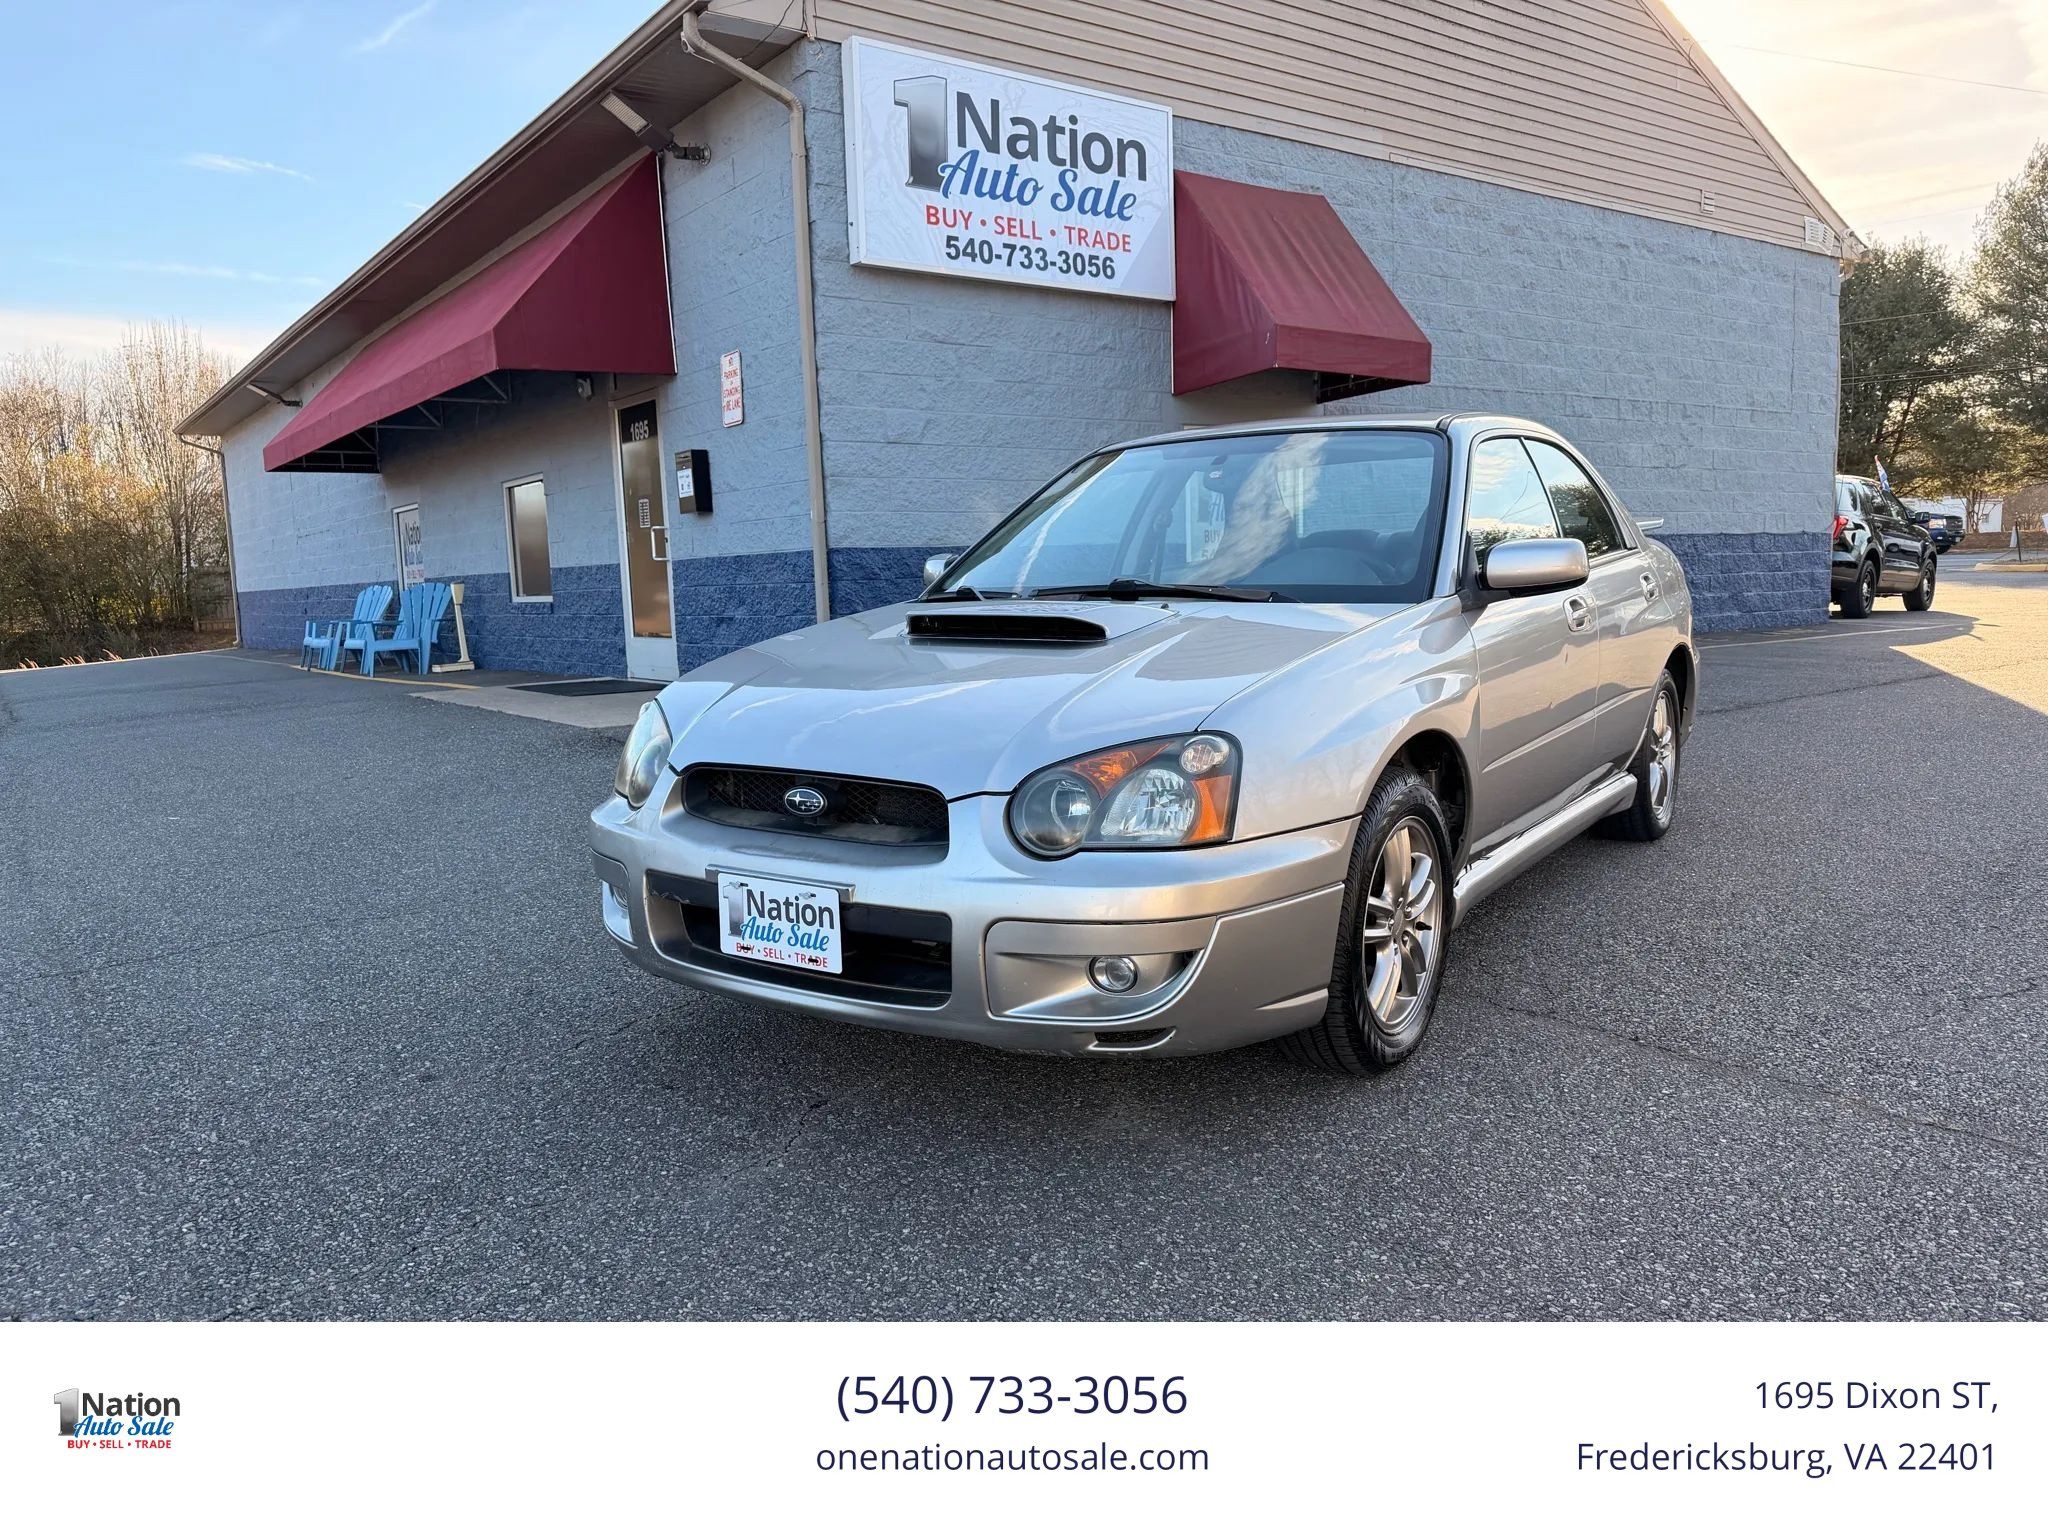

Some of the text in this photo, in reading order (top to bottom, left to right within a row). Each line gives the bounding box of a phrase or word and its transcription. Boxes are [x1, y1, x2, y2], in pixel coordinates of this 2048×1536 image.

[956, 91, 1147, 182] Nation
[939, 149, 1138, 222] Auto Sale
[926, 205, 1132, 253] BUY SELL TRADE
[945, 235, 1116, 280] 540-733-3056
[630, 419, 649, 441] 1695
[746, 889, 835, 930] Nation
[741, 916, 830, 952] Auto Sale
[763, 947, 785, 961] SELL
